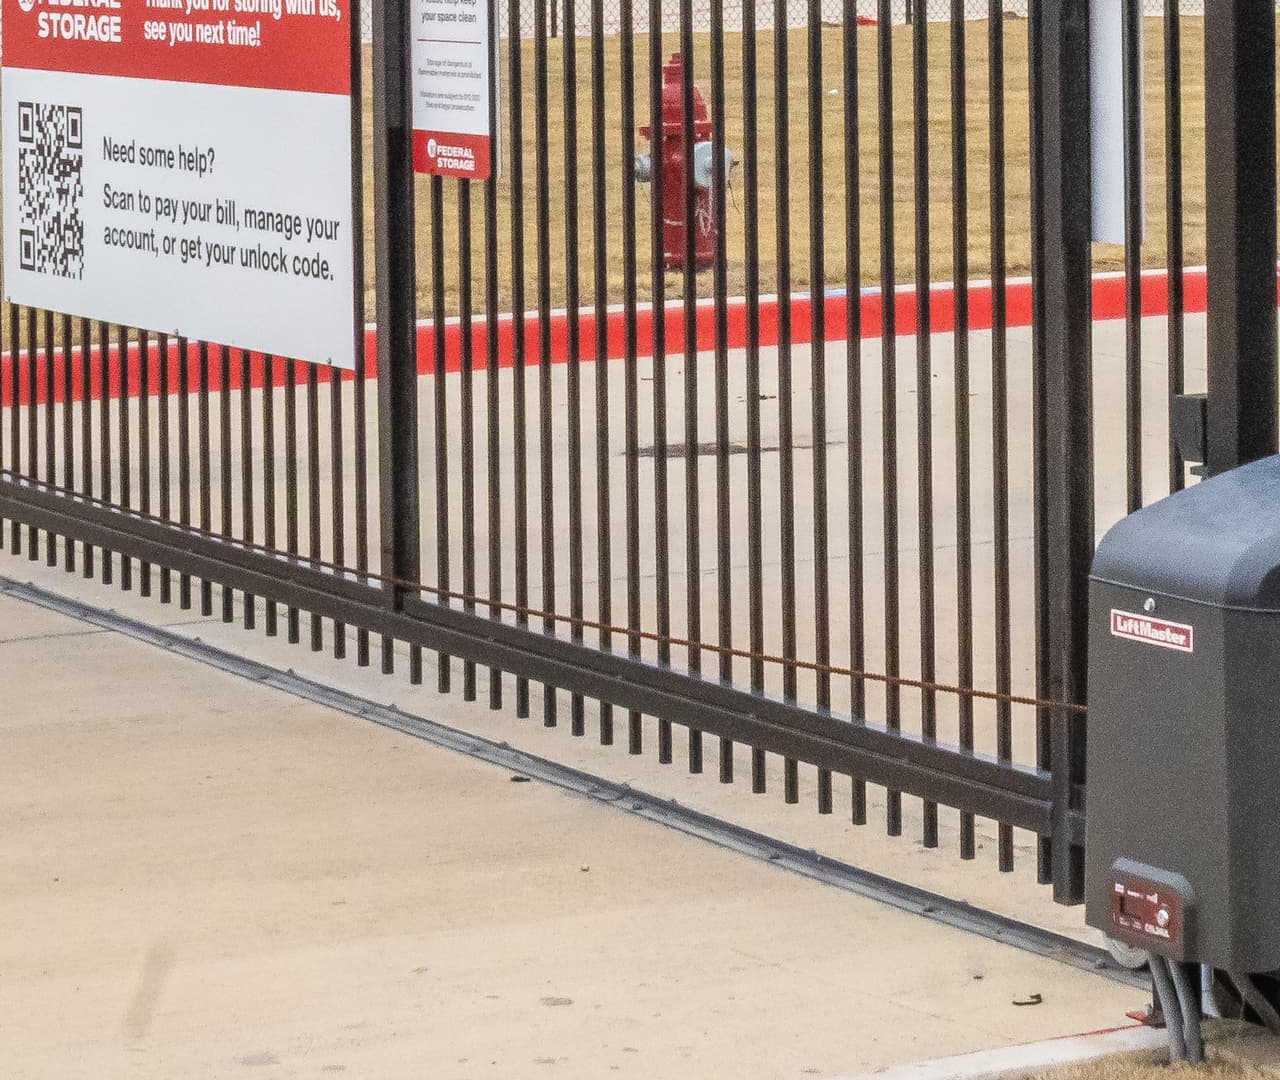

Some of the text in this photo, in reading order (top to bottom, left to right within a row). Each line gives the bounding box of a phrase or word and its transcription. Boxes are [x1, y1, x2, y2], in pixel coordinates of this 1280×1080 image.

[37, 11, 122, 43] STORAGE
[144, 20, 261, 47] see you next time!
[421, 12, 436, 24] your
[458, 12, 477, 23] clean
[103, 136, 215, 177] Need some help?
[437, 145, 475, 159] FEDERAL
[437, 157, 475, 171] STORAGE
[103, 183, 340, 243] Scan to pay your bill, manage your
[103, 226, 334, 281] account, or get your unlock code.
[1116, 615, 1187, 646] LiftMaster
